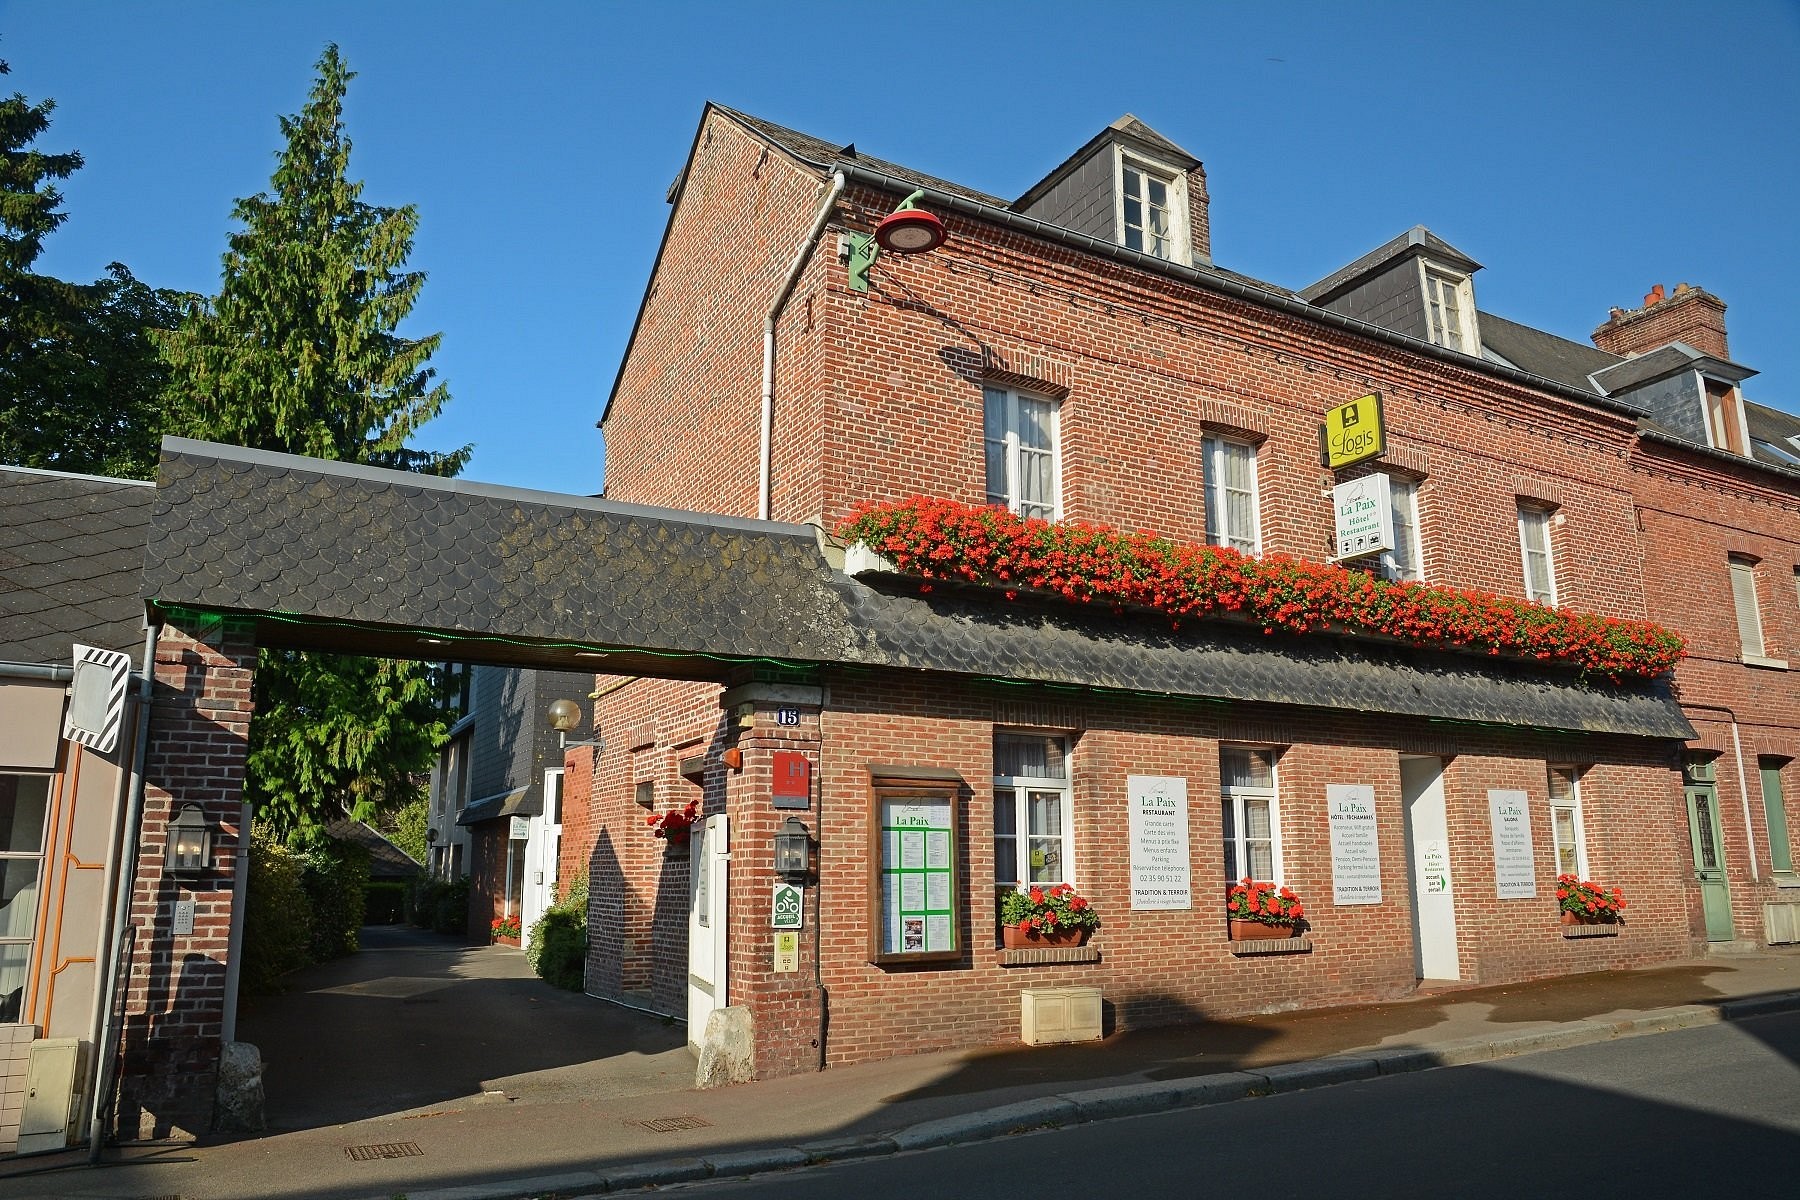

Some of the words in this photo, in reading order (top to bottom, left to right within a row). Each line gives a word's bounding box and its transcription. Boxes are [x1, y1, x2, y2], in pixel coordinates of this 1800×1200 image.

[1331, 428, 1374, 460] Logis
[1340, 505, 1353, 517] La
[1355, 497, 1377, 513] Paix
[1349, 514, 1370, 526] Hôtel
[1340, 521, 1380, 537] Restaurant
[780, 709, 798, 725] 15
[789, 761, 805, 777] H
[1141, 795, 1154, 807] La
[1156, 796, 1176, 808] Paix
[1339, 802, 1349, 813] La
[1351, 803, 1367, 813] Paix
[1498, 806, 1508, 815] La
[1508, 806, 1522, 815] Paix
[896, 816, 907, 826] La
[909, 816, 929, 826] Paix
[1140, 837, 1157, 845] Menus
[1151, 856, 1170, 864] Parking
[1139, 874, 1148, 882] 02
[1148, 874, 1157, 882] 35
[1165, 875, 1173, 883] 51
[1174, 875, 1183, 883] 22
[1134, 889, 1162, 897] TRADITION
[1167, 889, 1189, 897] TERROIR
